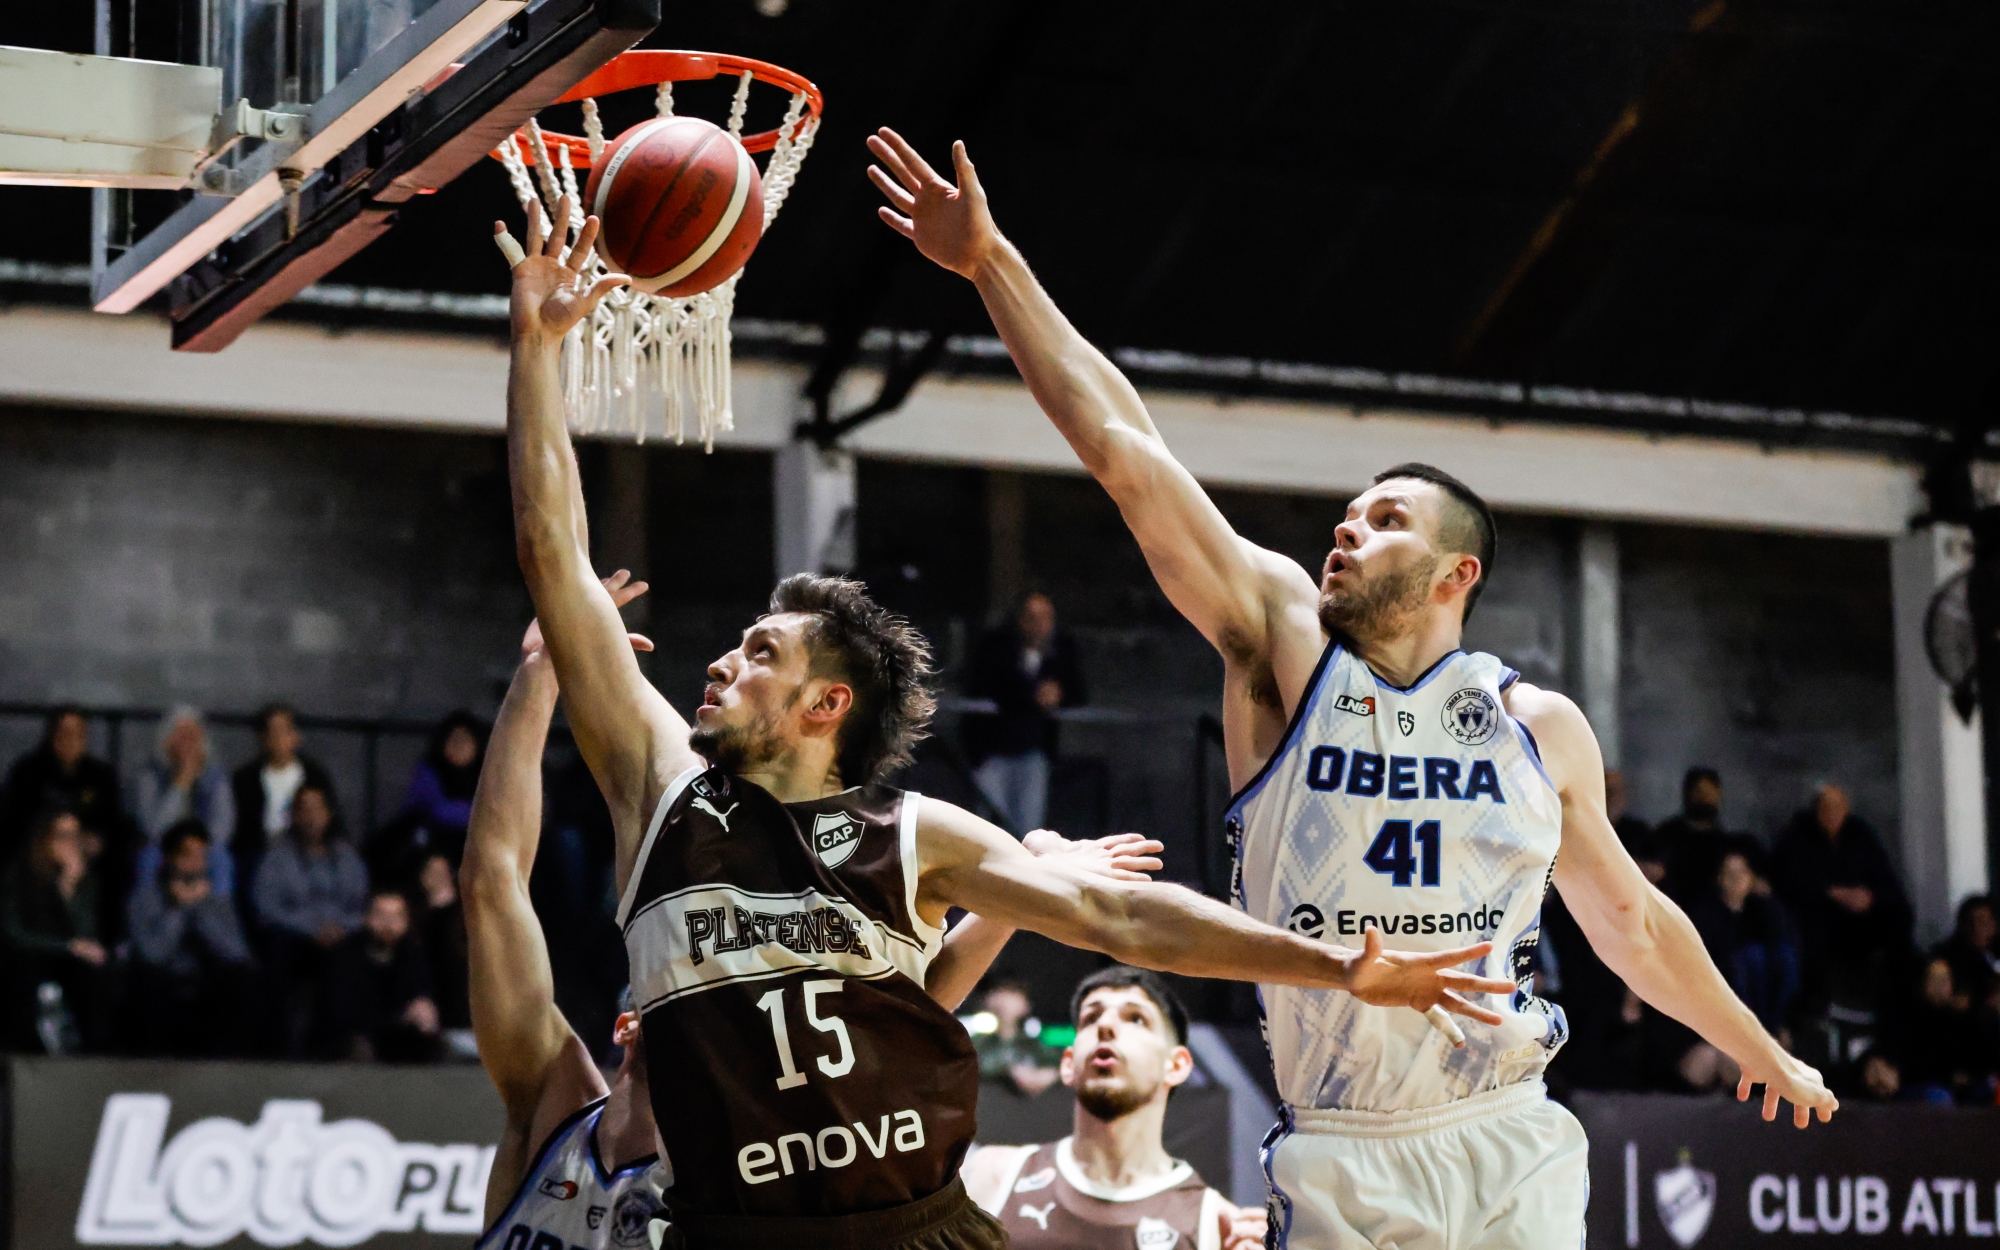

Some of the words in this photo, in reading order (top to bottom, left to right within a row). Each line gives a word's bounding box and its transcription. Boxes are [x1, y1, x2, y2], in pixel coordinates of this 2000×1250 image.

[1336, 697, 1370, 715] LNB
[1306, 745, 1506, 805] OBERA
[820, 825, 853, 848] CAP
[1363, 819, 1441, 887] 41
[1337, 904, 1504, 935] Envasando
[756, 979, 855, 1091] 15
[737, 1109, 925, 1185] enova
[1750, 1174, 1890, 1234] CLUB
